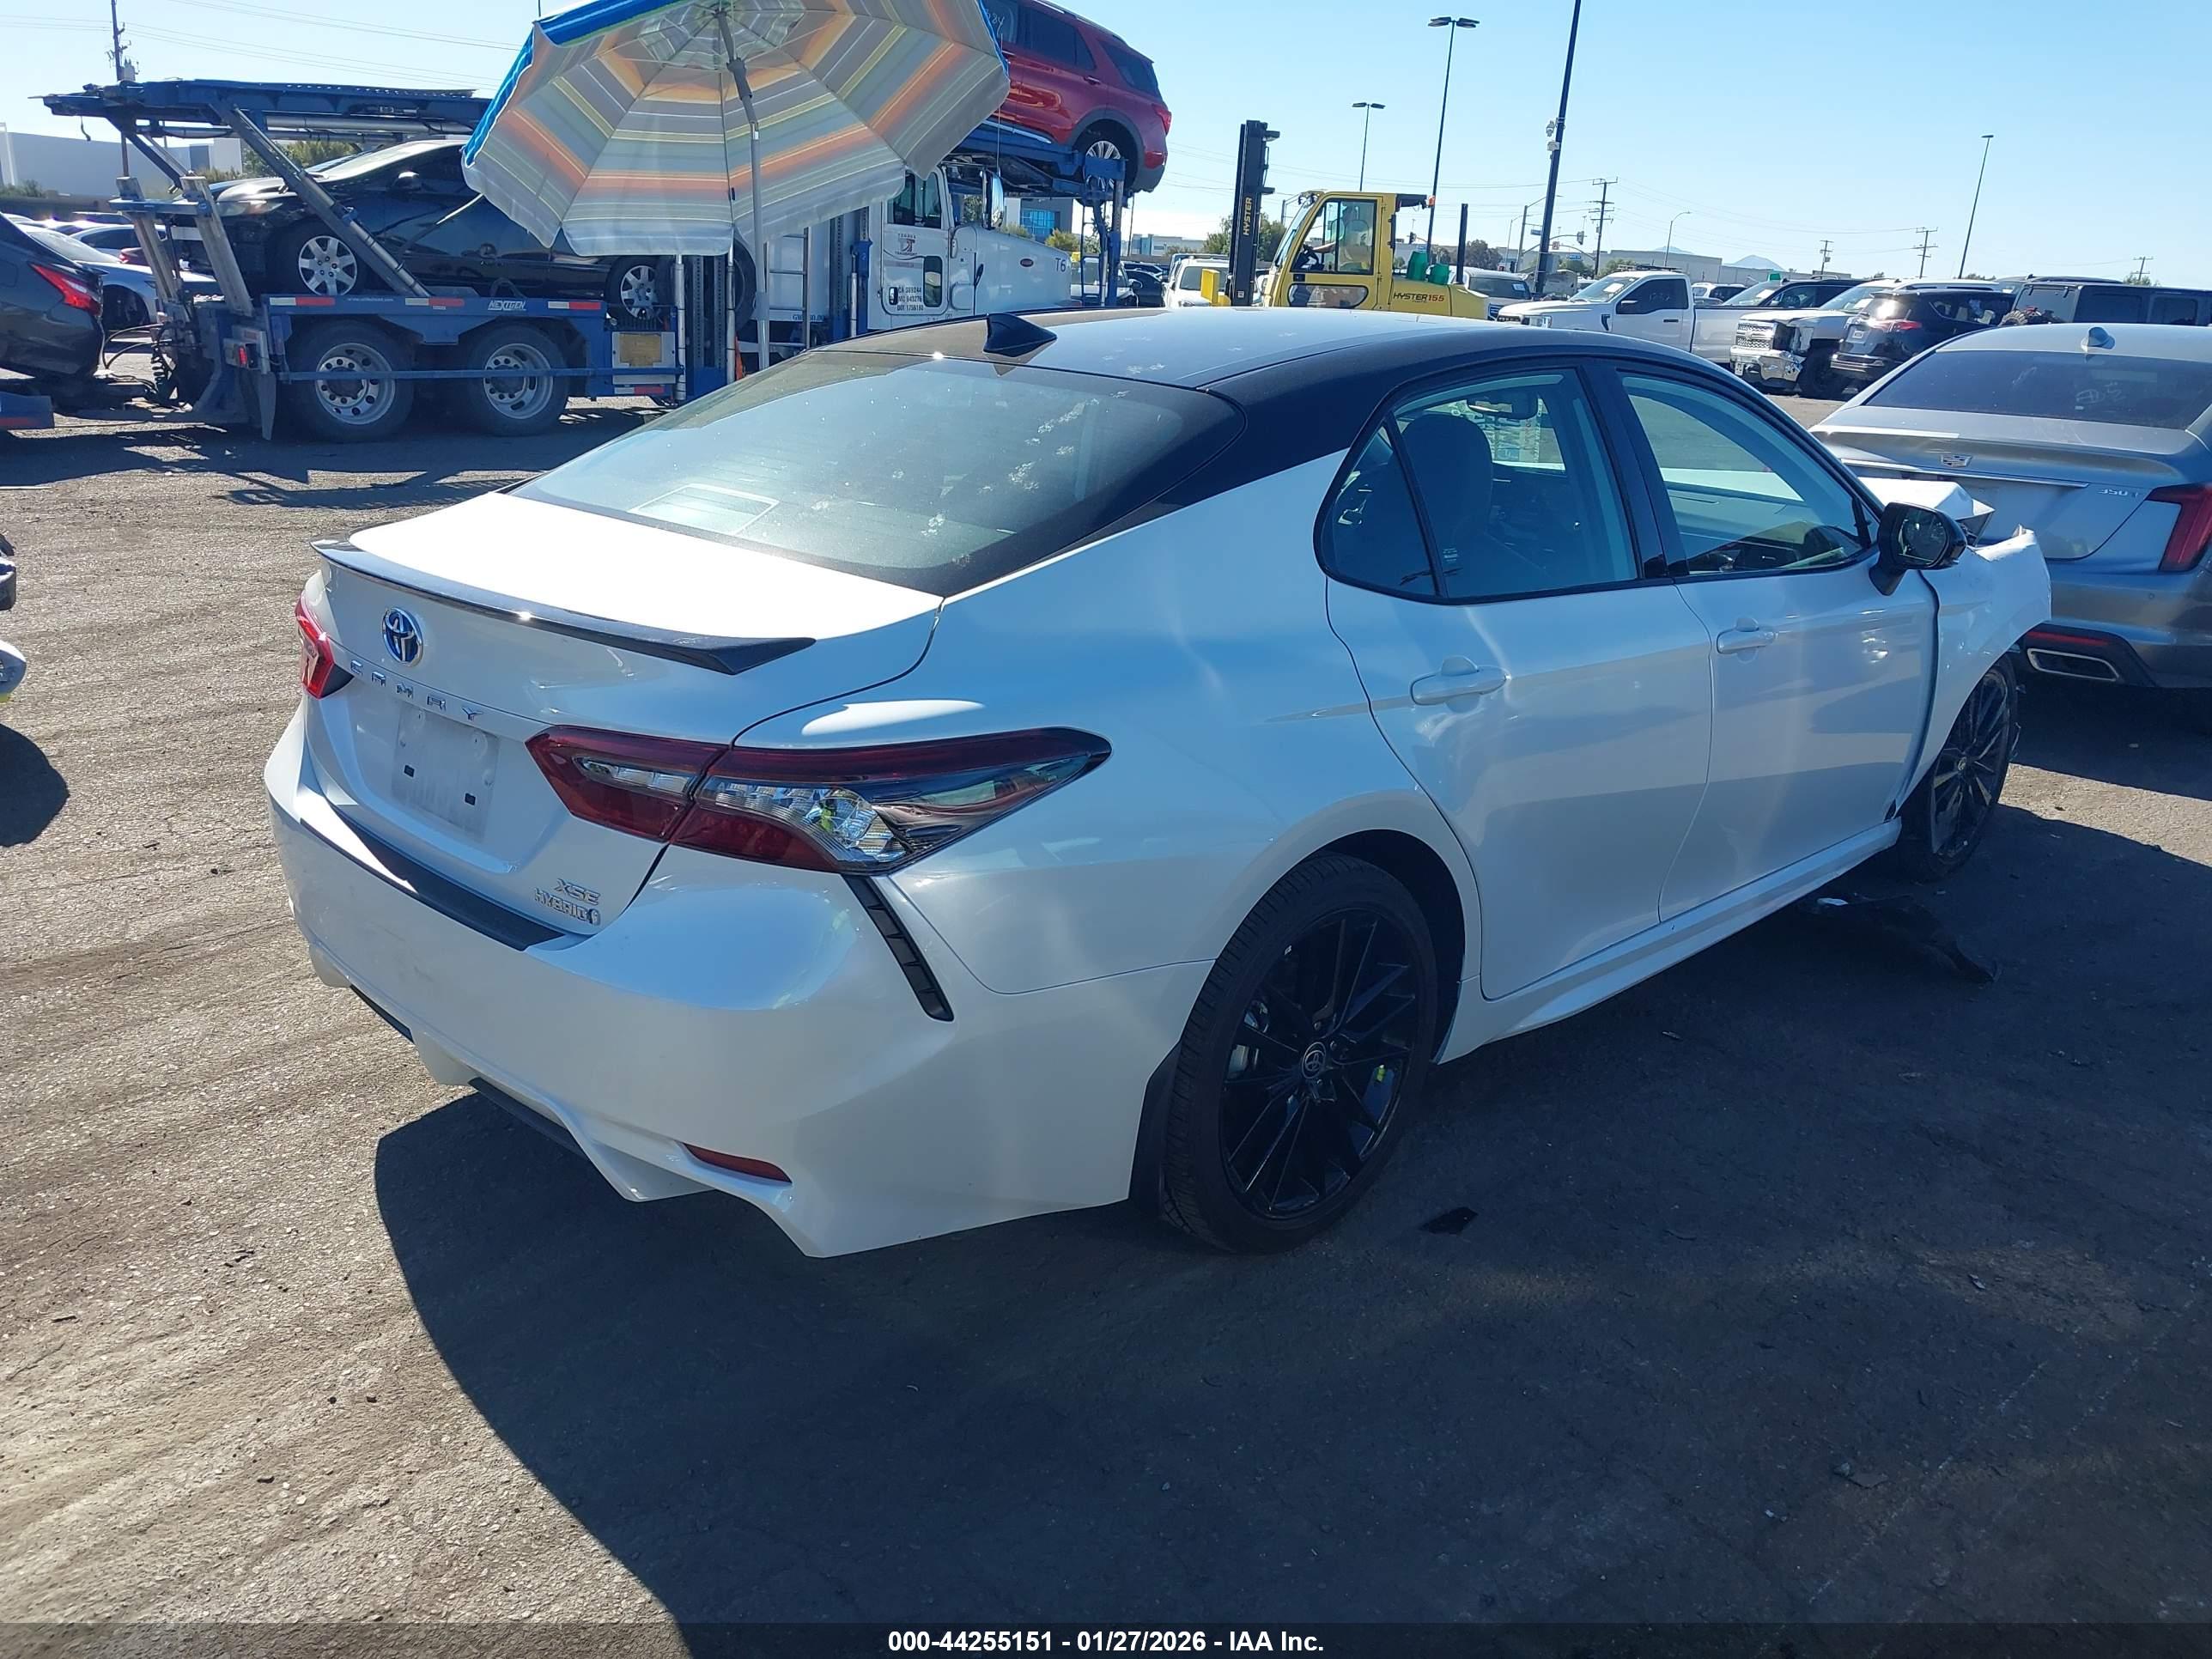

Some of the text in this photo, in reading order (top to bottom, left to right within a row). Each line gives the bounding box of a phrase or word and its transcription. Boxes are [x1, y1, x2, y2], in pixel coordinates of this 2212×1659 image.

[1243, 197, 1253, 236] HYSTER
[1055, 258, 1066, 272] T6
[488, 300, 527, 311] NEXTGEN
[349, 659, 483, 721] CAMRY
[534, 887, 589, 921] HYBRID
[554, 878, 600, 906] XSE
